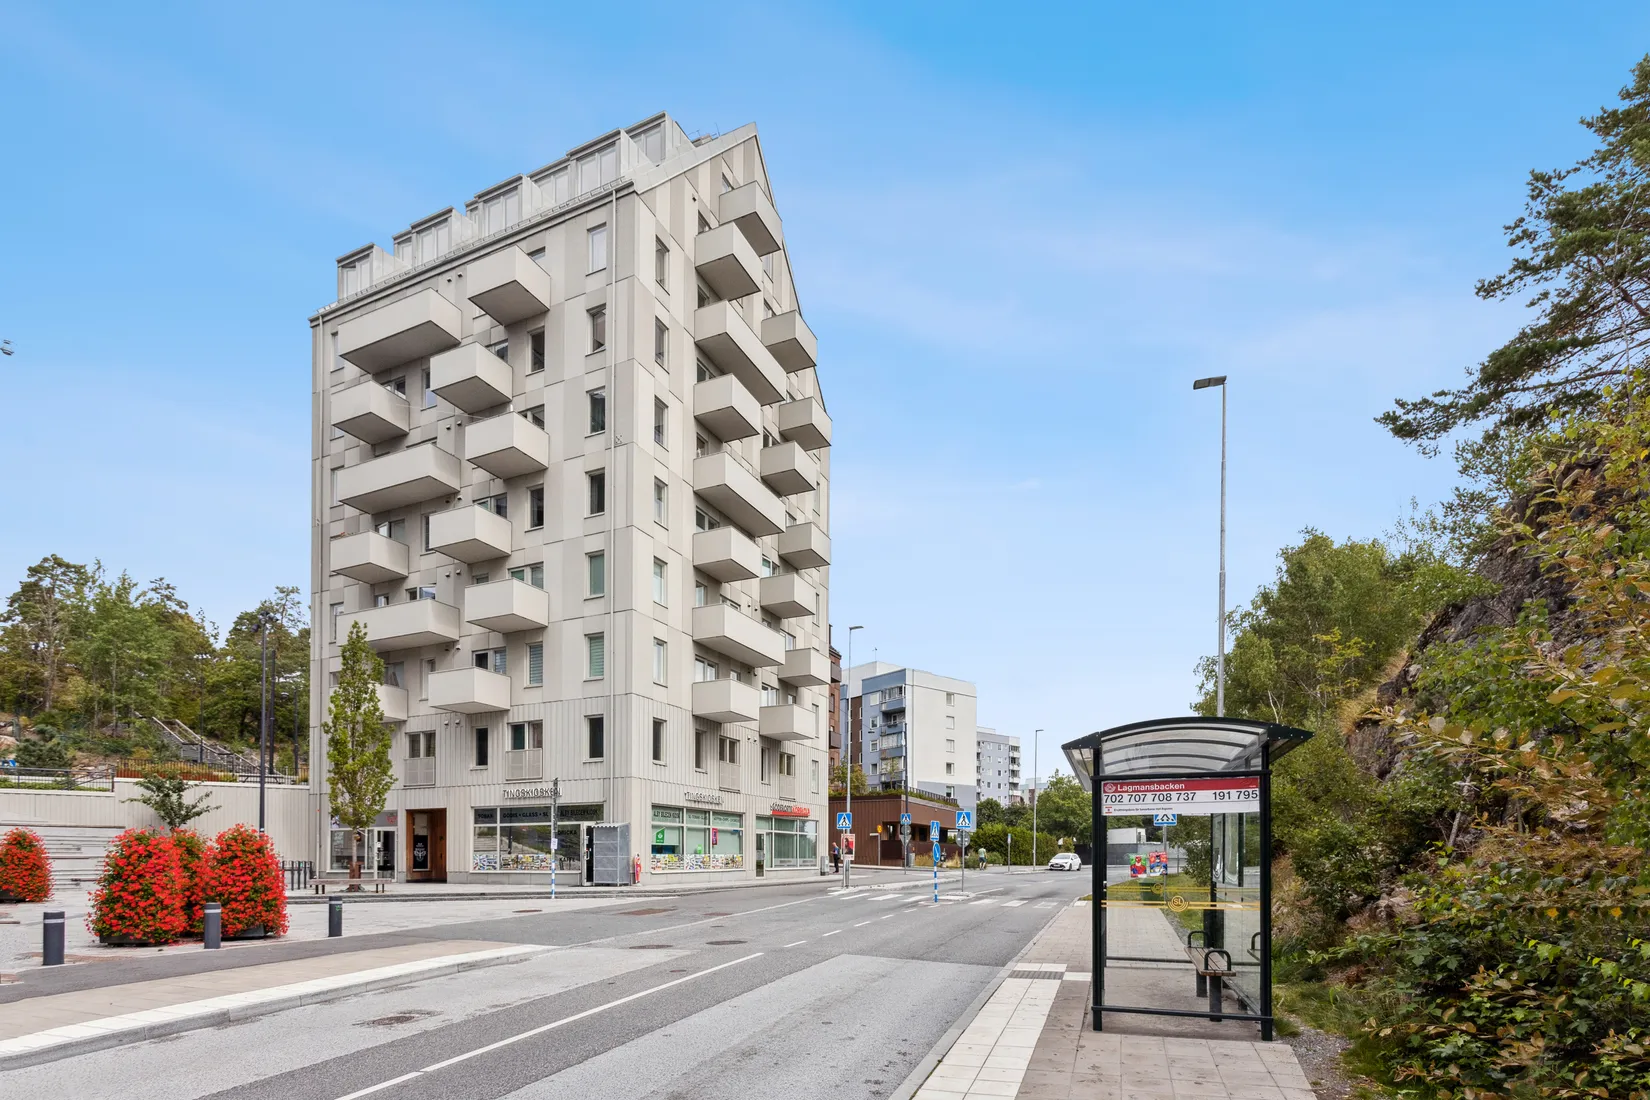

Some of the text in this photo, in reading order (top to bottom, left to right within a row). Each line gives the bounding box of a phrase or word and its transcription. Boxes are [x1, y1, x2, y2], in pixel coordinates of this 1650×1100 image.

[1117, 783, 1185, 793] Lagmansbacken
[1104, 789, 1258, 804] 702 707 708 737 191 795
[1173, 898, 1183, 906] SL
